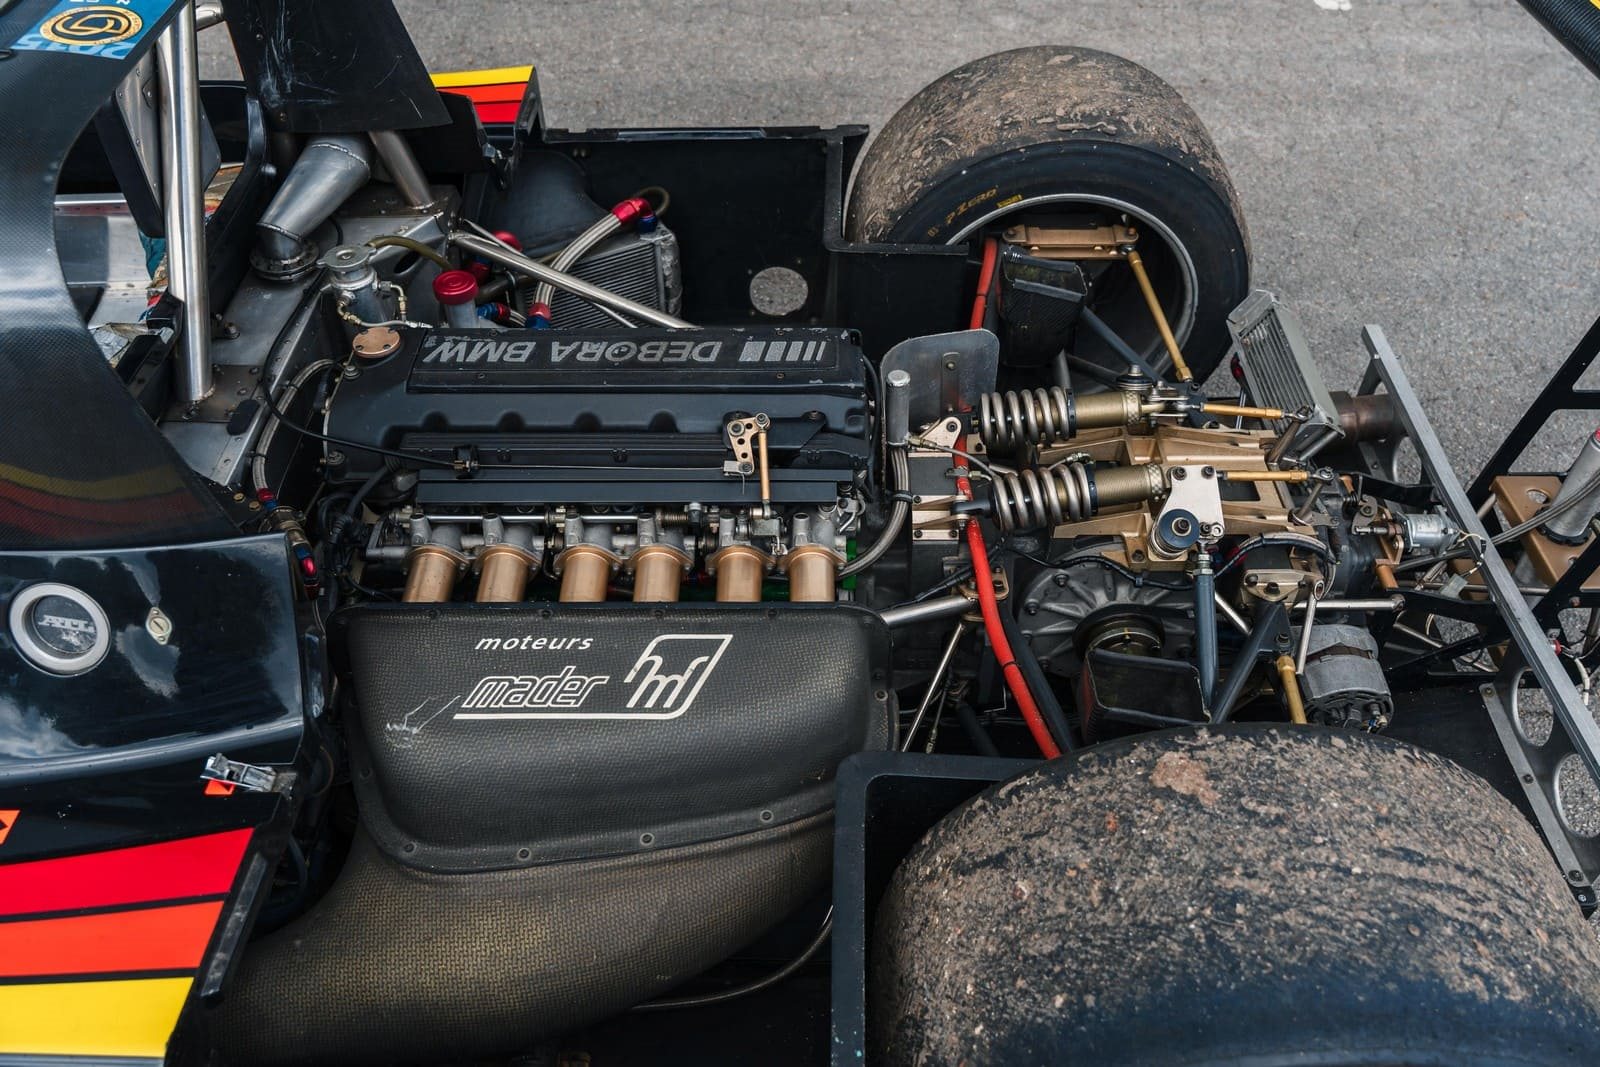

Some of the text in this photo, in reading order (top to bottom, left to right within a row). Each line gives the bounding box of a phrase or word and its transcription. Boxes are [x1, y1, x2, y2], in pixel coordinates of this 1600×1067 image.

[423, 341, 723, 363] DEBORA BMW
[474, 635, 594, 650] moteurs
[461, 666, 610, 708] mader
